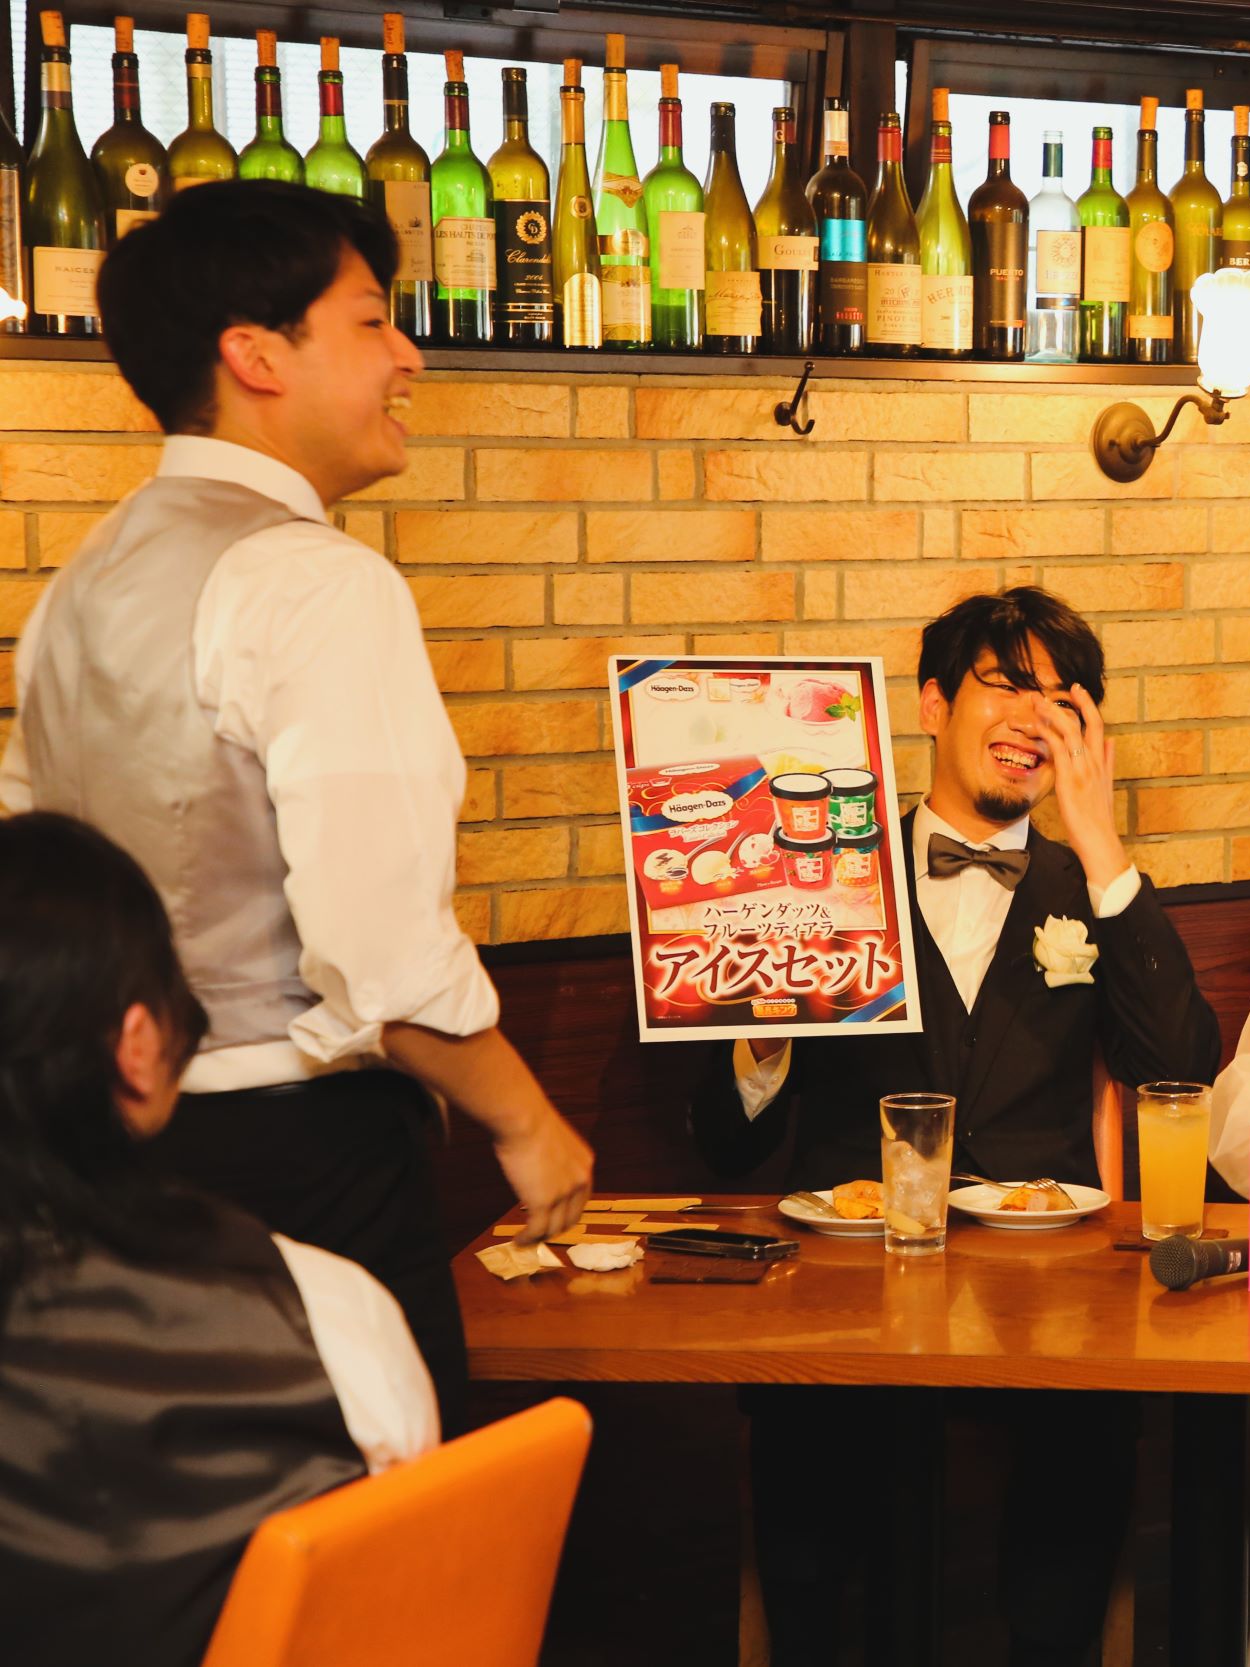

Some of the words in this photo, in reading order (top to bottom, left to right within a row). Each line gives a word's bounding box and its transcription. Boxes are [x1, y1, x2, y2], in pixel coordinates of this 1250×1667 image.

[704, 903, 831, 919] ハーゲンダッツ&
[703, 921, 834, 938] フルーツティアラ
[656, 941, 890, 994] アイスセット
